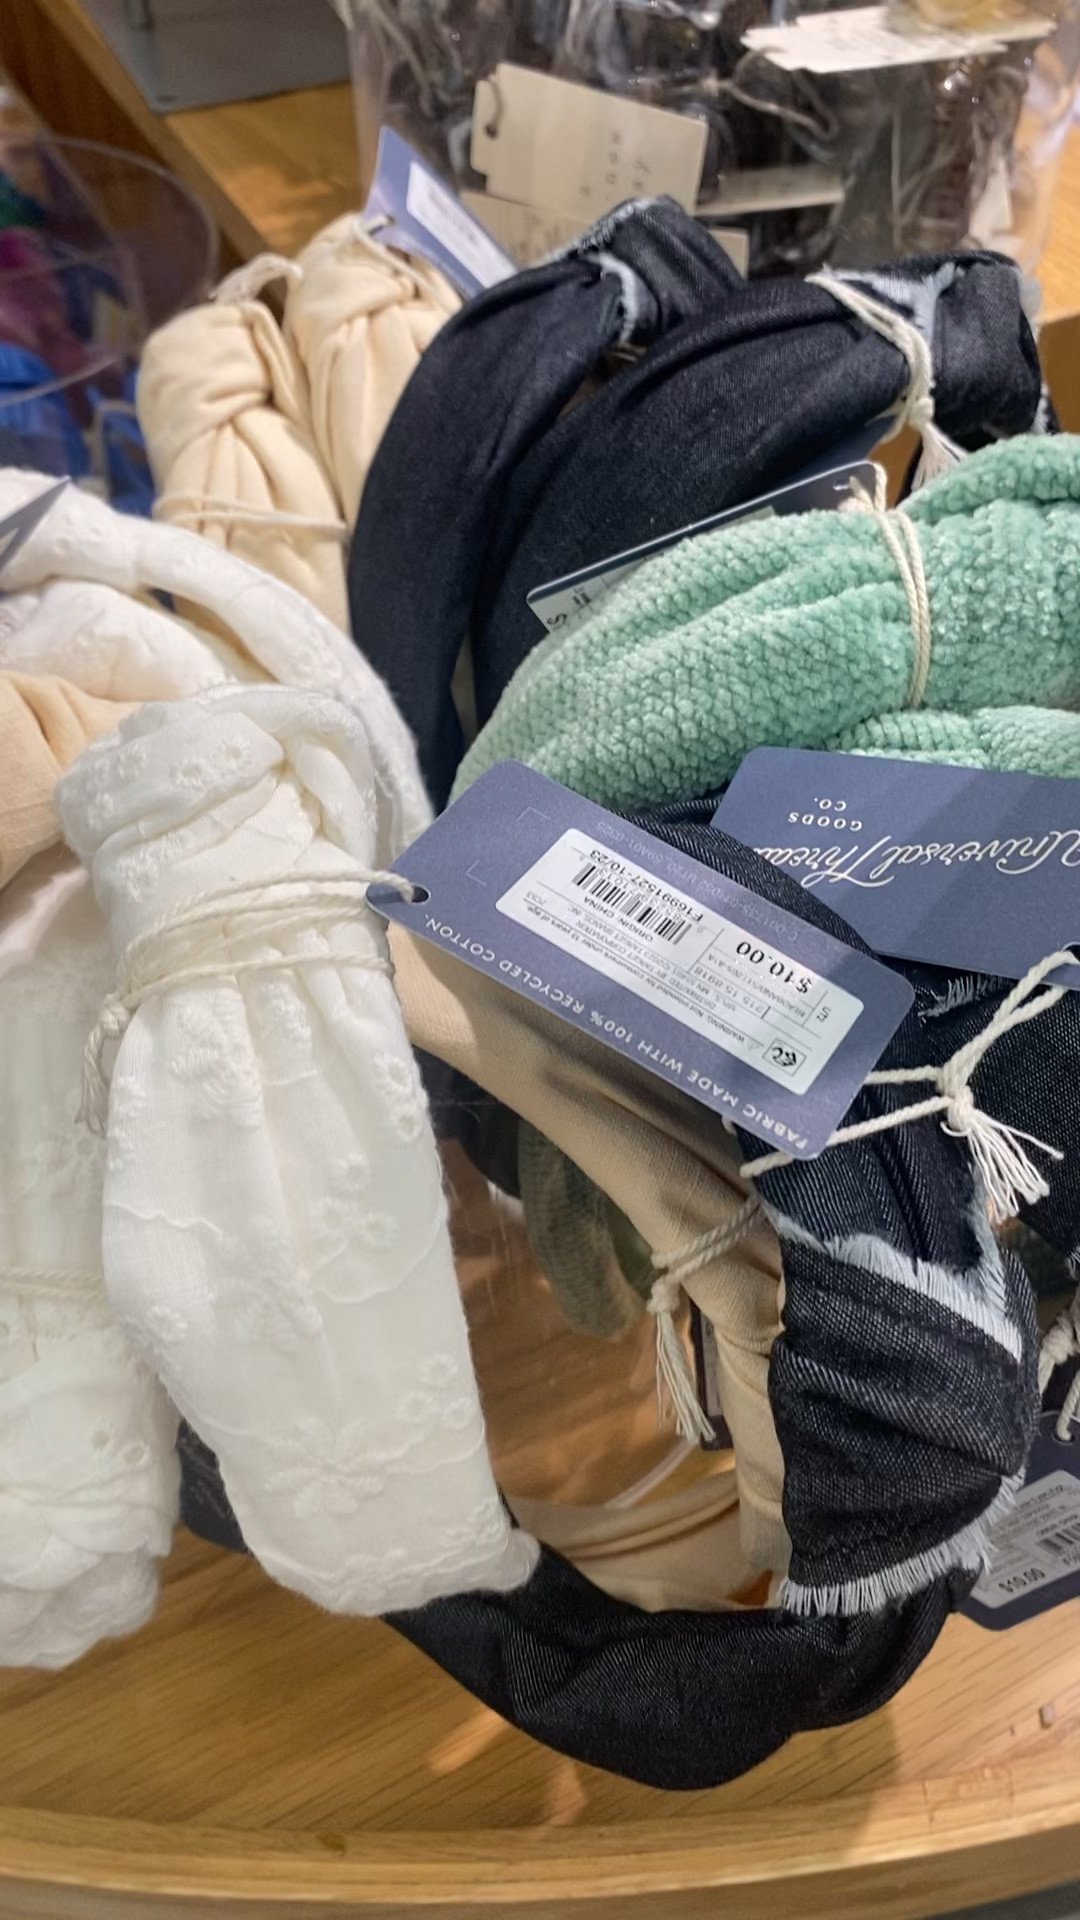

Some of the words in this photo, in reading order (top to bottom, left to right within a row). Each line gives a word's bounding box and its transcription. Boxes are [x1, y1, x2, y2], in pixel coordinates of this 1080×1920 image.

[788, 811, 863, 832] GOODS
[813, 797, 847, 812] CO.
[753, 834, 894, 888] Threa
[869, 829, 1080, 880] Universal
[581, 895, 615, 919] CHINA
[588, 847, 704, 923] F16991527-10/23
[419, 912, 496, 964] COTTON.
[496, 955, 585, 1016] RECYCLED
[733, 938, 813, 996] $10.00
[587, 1009, 634, 1044] 100%
[636, 1039, 685, 1074] WITH
[685, 1068, 740, 1108] MADE
[741, 1102, 809, 1149] FABRIC
